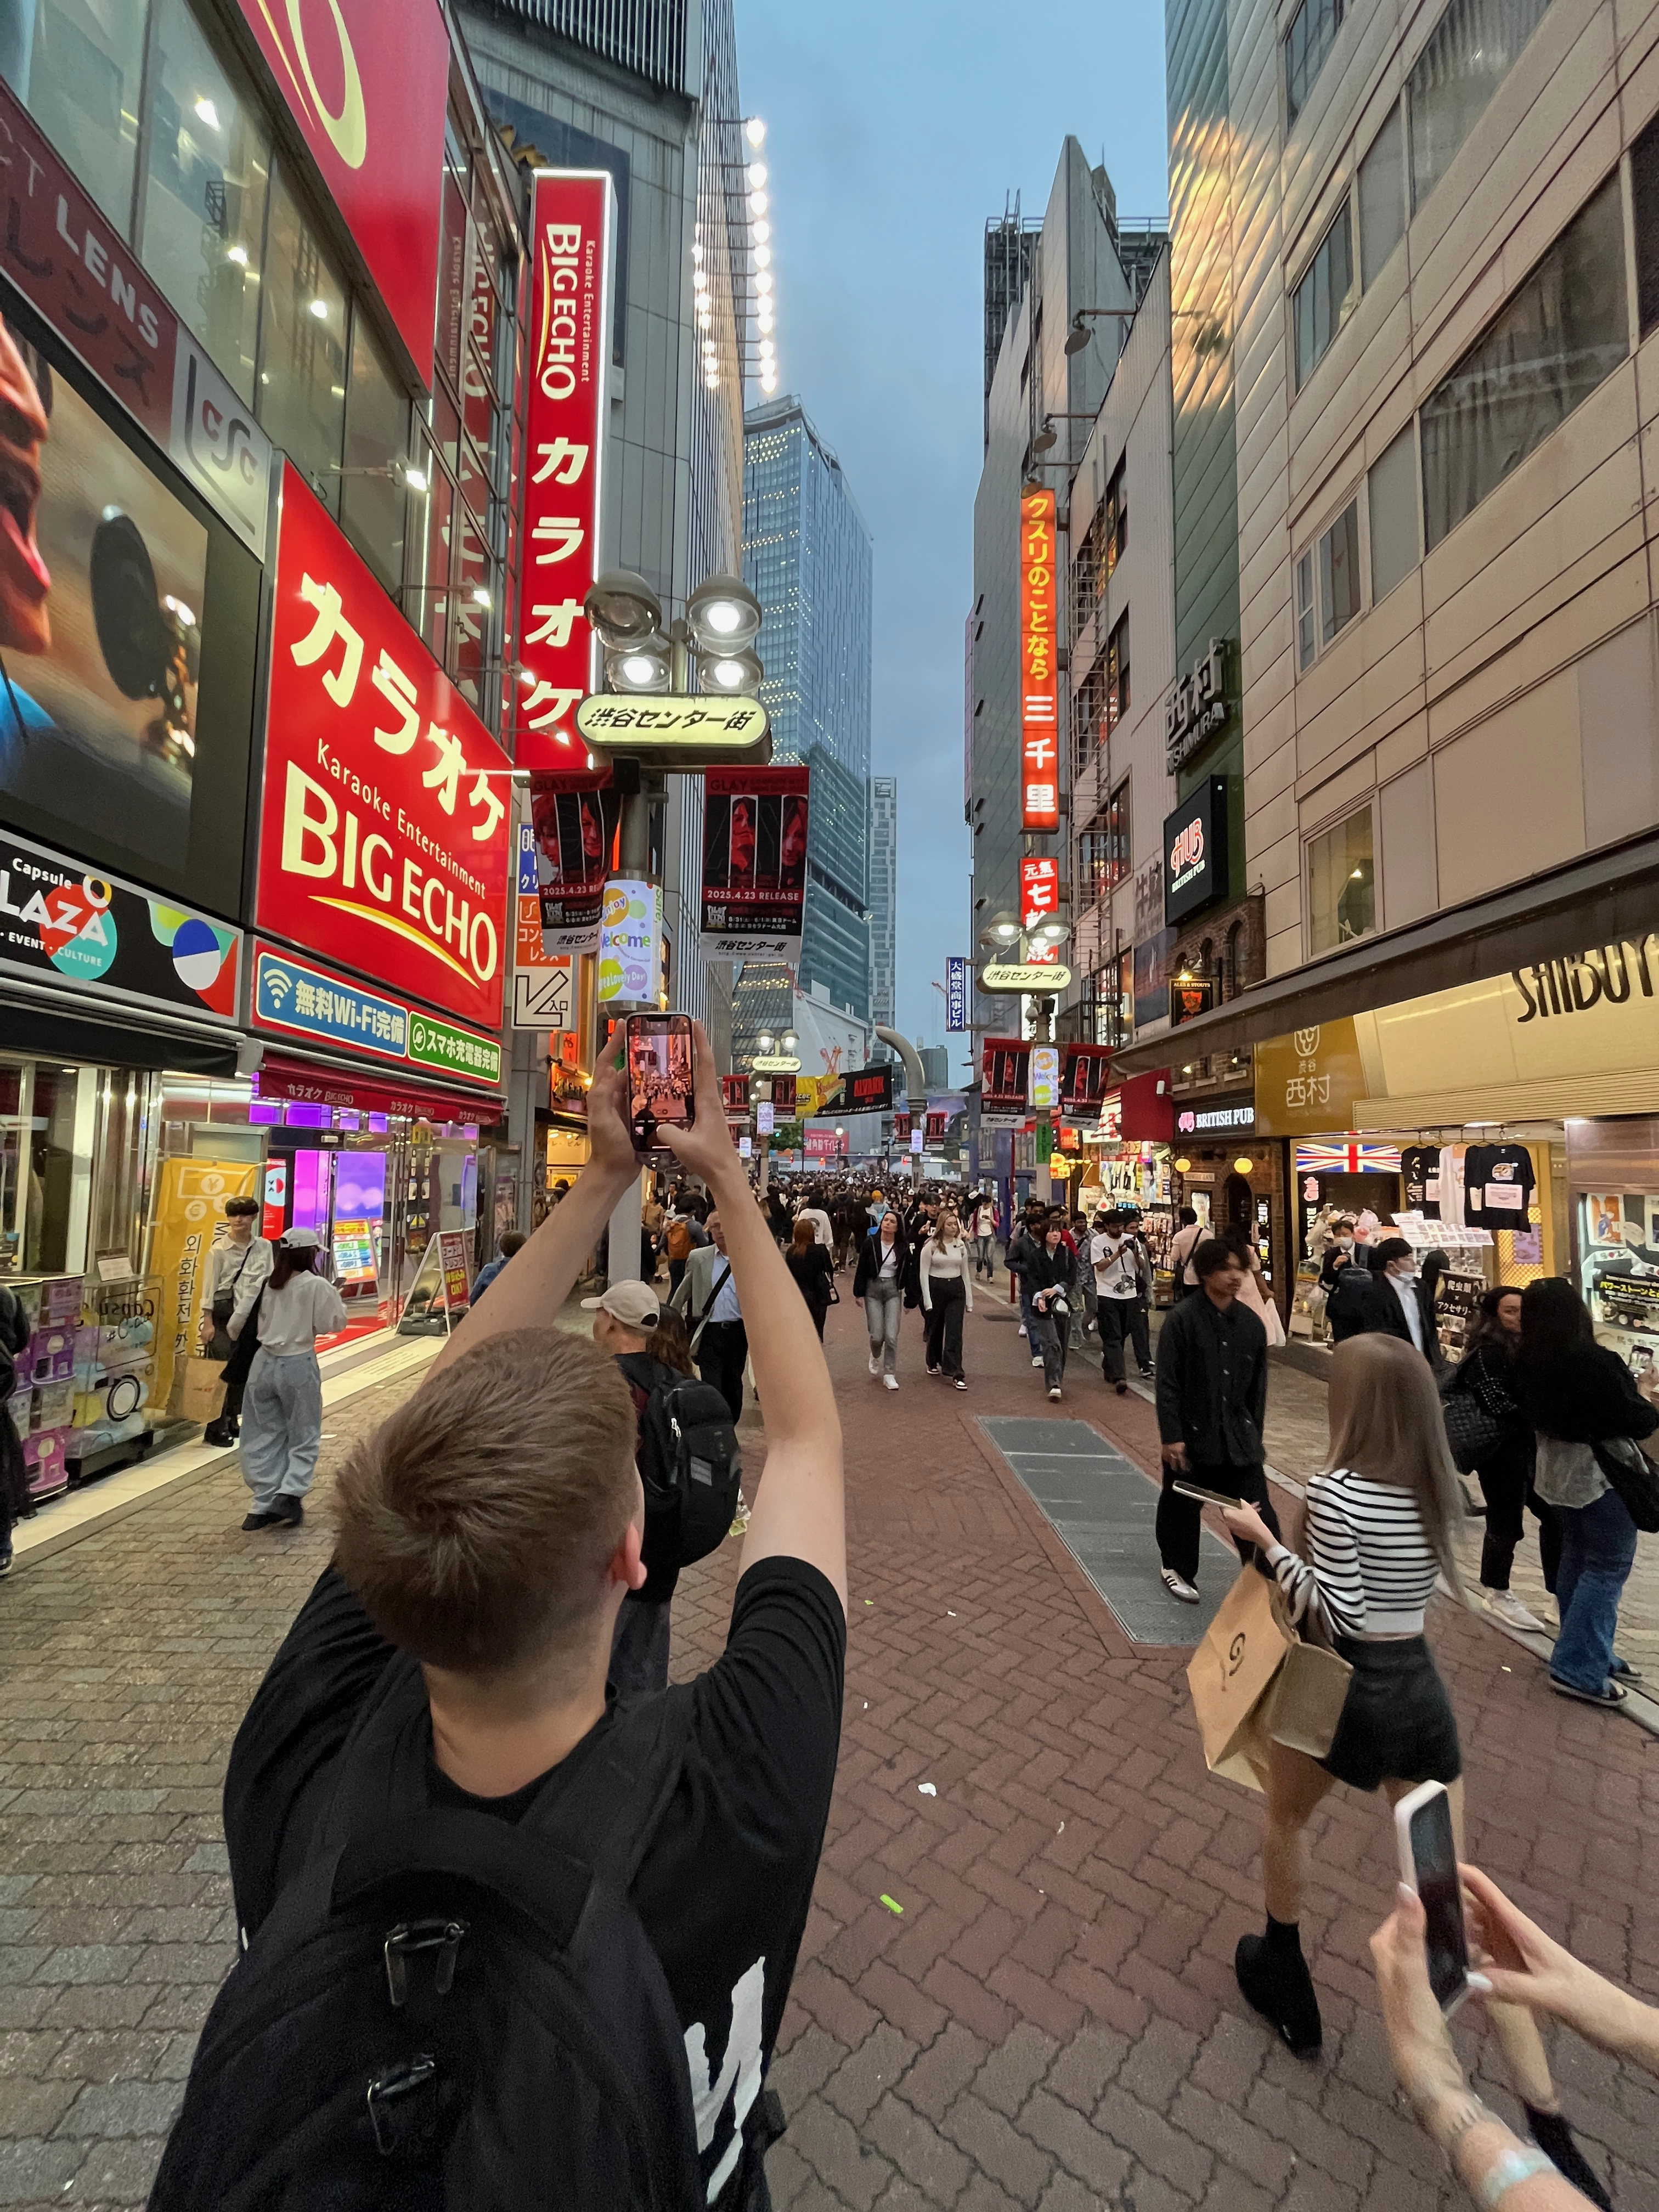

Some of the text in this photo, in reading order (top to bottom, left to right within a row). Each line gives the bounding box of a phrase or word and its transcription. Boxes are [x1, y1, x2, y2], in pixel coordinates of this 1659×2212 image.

[56, 194, 159, 348] LENS
[541, 223, 582, 400] BIG ECHO
[581, 240, 596, 382] Karaoke Entertainment
[522, 437, 589, 730] カラオケ
[1027, 498, 1050, 680] クスリのことなら
[290, 572, 505, 842] カラオケ
[584, 706, 757, 732] 渋谷センター街
[1024, 695, 1056, 812] 三千里
[710, 779, 749, 792] GLAY
[317, 738, 486, 900] Karaoke Entertainment
[1170, 817, 1204, 878] HUB
[12, 857, 72, 891] Capsule
[280, 759, 498, 982] BIG ECHO
[1171, 868, 1194, 894] BRITISH
[1193, 859, 1206, 877] PUB
[543, 885, 587, 896] 2025.4.23
[707, 890, 799, 901] 2025.4.23 RELEASE
[8, 932, 103, 968] EVENT CULTURE
[714, 940, 788, 952] 渋谷センター街
[986, 970, 1067, 981] 渋谷センター街
[295, 980, 405, 1046] 無料Wi-Fi完備
[549, 999, 568, 1012] 入口
[426, 1029, 498, 1073] スマホ充電器完備
[287, 1084, 323, 1100] カラオケ
[391, 1101, 414, 1114] カラオケ
[1286, 1073, 1331, 1108] 西村
[1196, 1109, 1233, 1129] BRITISH
[1233, 1107, 1255, 1125] PUB
[176, 1234, 201, 1325] 외화환전
[1600, 1280, 1659, 1298] パワーストーンと
